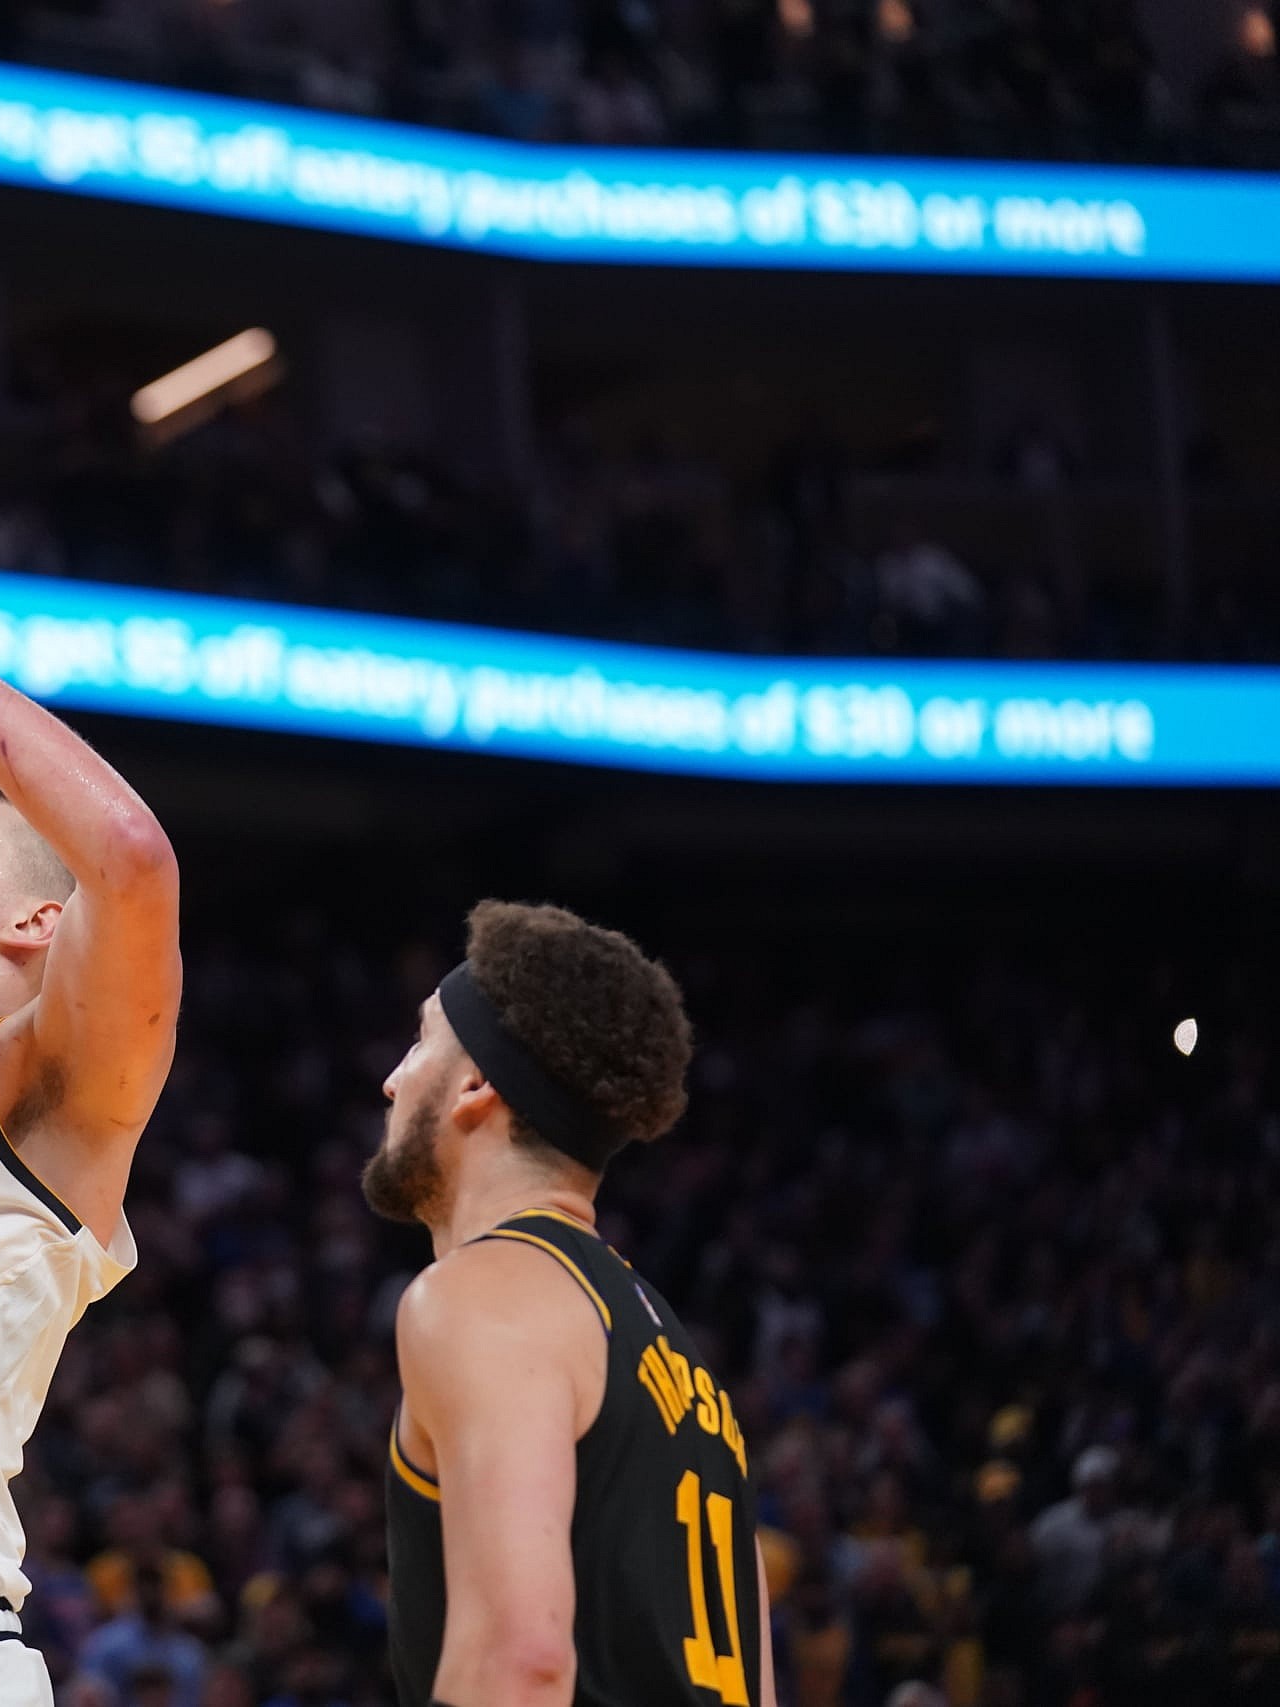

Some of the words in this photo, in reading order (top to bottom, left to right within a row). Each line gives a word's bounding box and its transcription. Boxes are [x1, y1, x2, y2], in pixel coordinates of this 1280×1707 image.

[742, 176, 806, 245] of
[922, 194, 983, 250] or
[993, 196, 1145, 256] more
[732, 680, 798, 755] of
[920, 697, 982, 758] or
[993, 699, 1153, 761] more
[676, 1469, 750, 1706] 11
